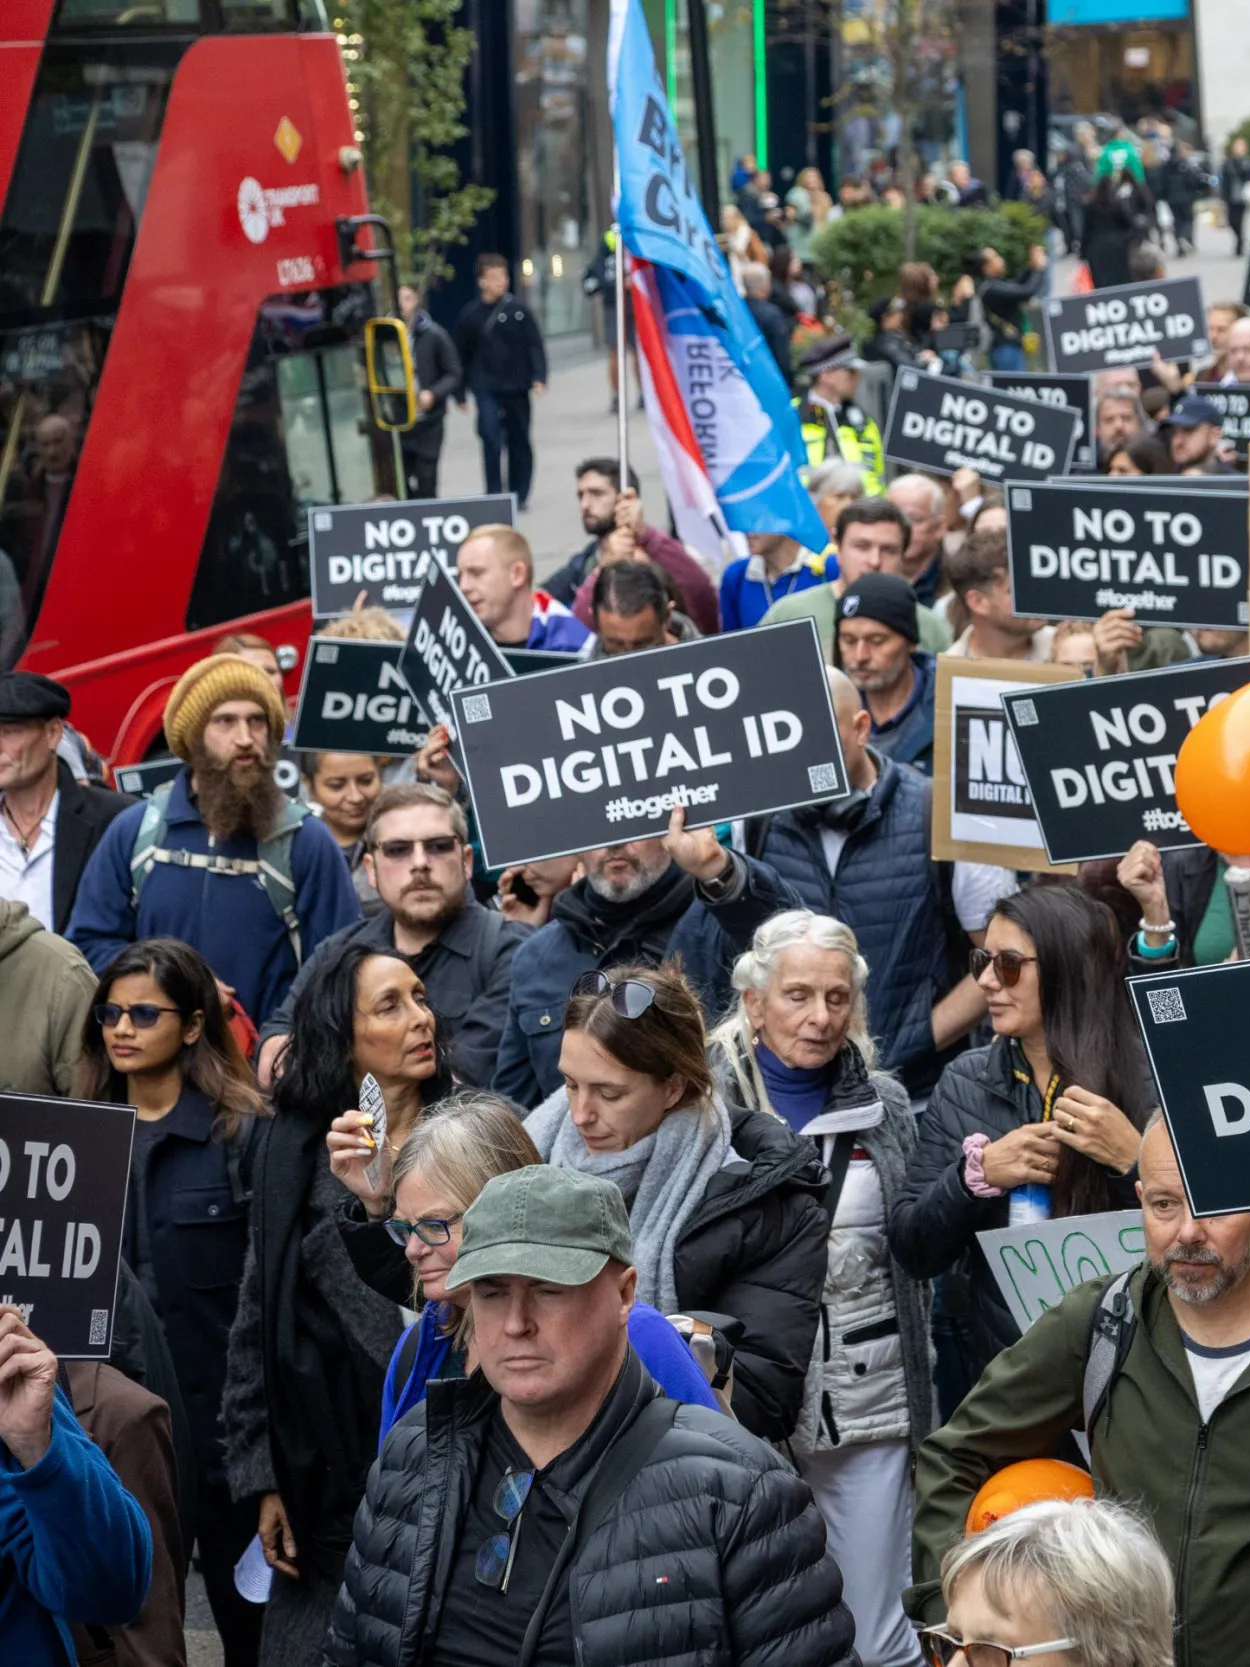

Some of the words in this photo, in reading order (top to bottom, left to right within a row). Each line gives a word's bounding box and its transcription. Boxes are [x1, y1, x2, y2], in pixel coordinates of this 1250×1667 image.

[1085, 299, 1128, 327] NO
[1130, 293, 1169, 319] TO
[1061, 319, 1163, 355] DIGITAL
[1165, 313, 1195, 339] ID
[940, 393, 988, 425] NO
[994, 404, 1035, 437] TO
[902, 411, 1016, 462] DIGITAL
[1021, 441, 1055, 470] ID
[365, 519, 416, 549] NO
[422, 515, 470, 545] TO
[1073, 507, 1135, 543] NO
[1144, 511, 1202, 547] TO
[1030, 545, 1189, 587] DIGITAL
[1198, 554, 1241, 588] ID
[1096, 589, 1177, 612] #together
[414, 617, 463, 699] DIGIT
[439, 605, 467, 660] NO
[465, 644, 490, 686] TO
[378, 661, 407, 690] N
[321, 691, 432, 725] DIGI
[555, 686, 645, 741] NO
[657, 667, 740, 718] TO
[1089, 703, 1167, 751] NO
[1174, 692, 1233, 730] T
[500, 726, 732, 808] DIGITAL
[743, 710, 803, 758] ID
[604, 782, 720, 823] #together
[968, 781, 1023, 804] DIGITAL
[1050, 754, 1176, 809] DIGIT
[24, 1141, 76, 1201] TO
[61, 1221, 101, 1279] ID
